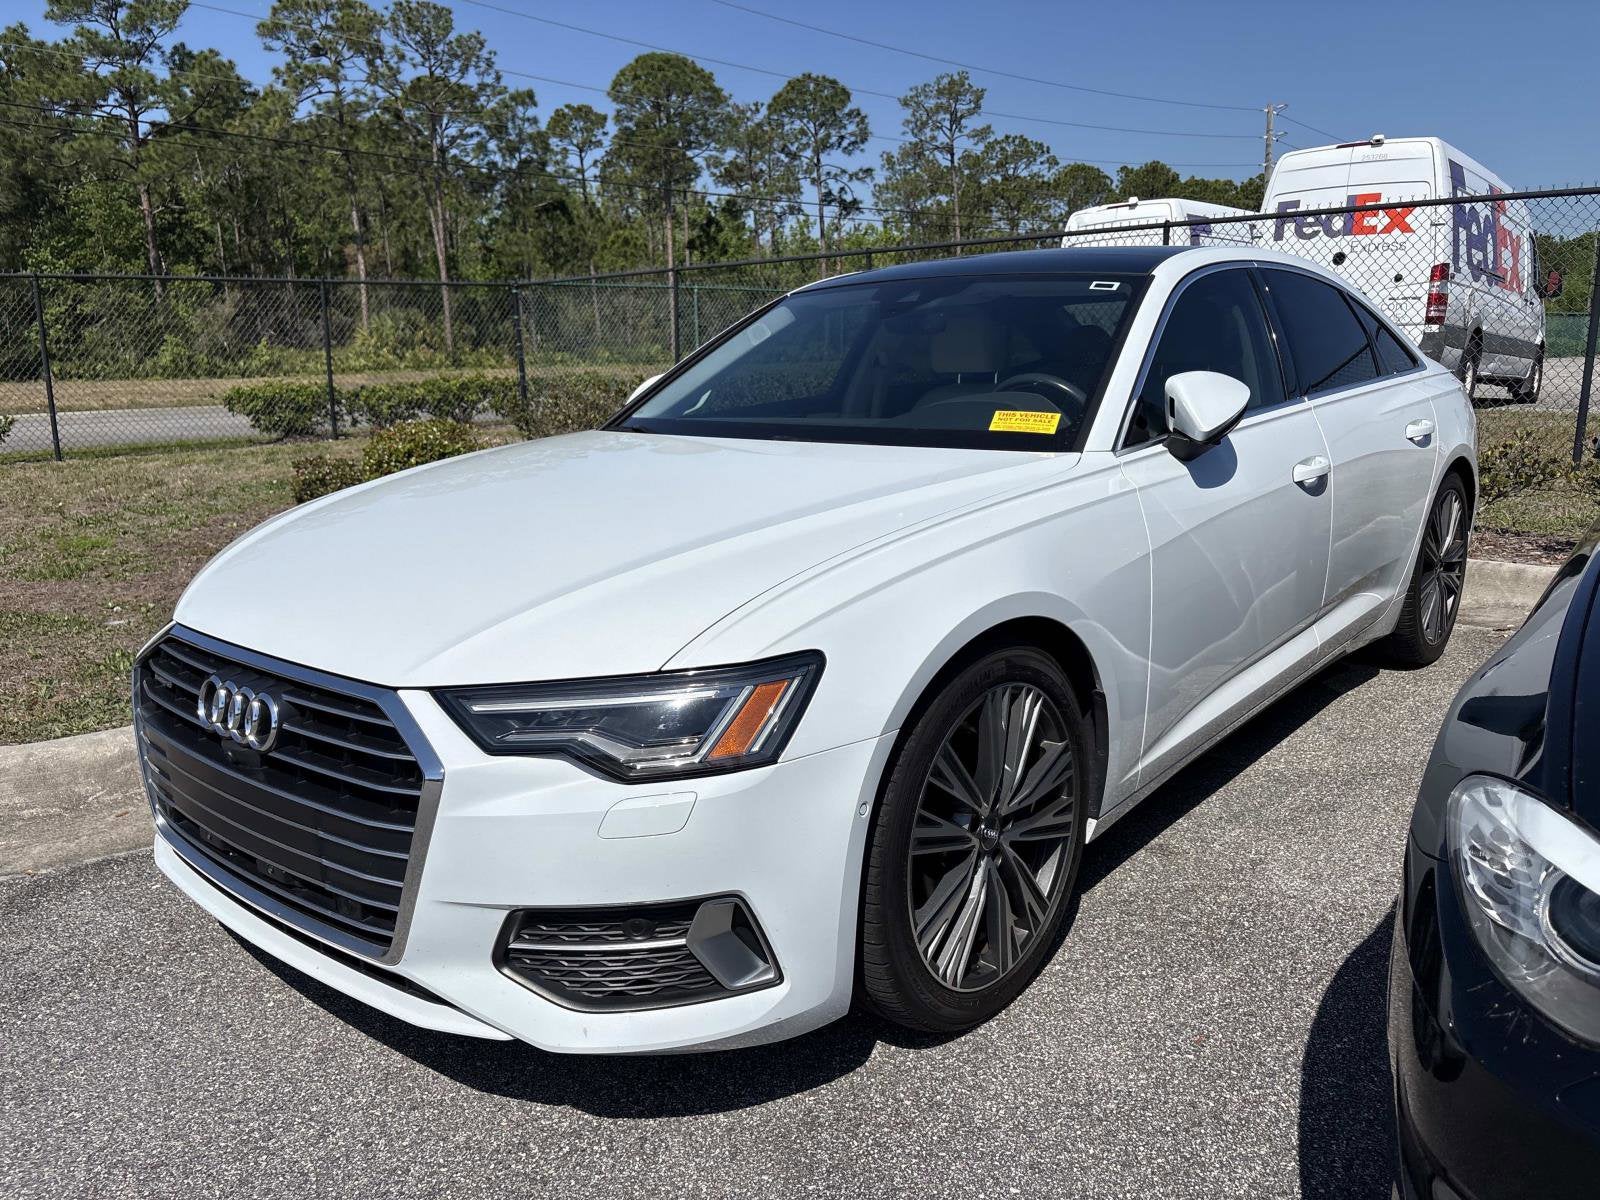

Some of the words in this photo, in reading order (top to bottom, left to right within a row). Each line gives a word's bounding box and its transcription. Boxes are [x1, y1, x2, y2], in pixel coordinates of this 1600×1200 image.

[1273, 192, 1416, 242] FedEx
[1448, 158, 1525, 296] FedEx
[1350, 240, 1407, 253] Express
